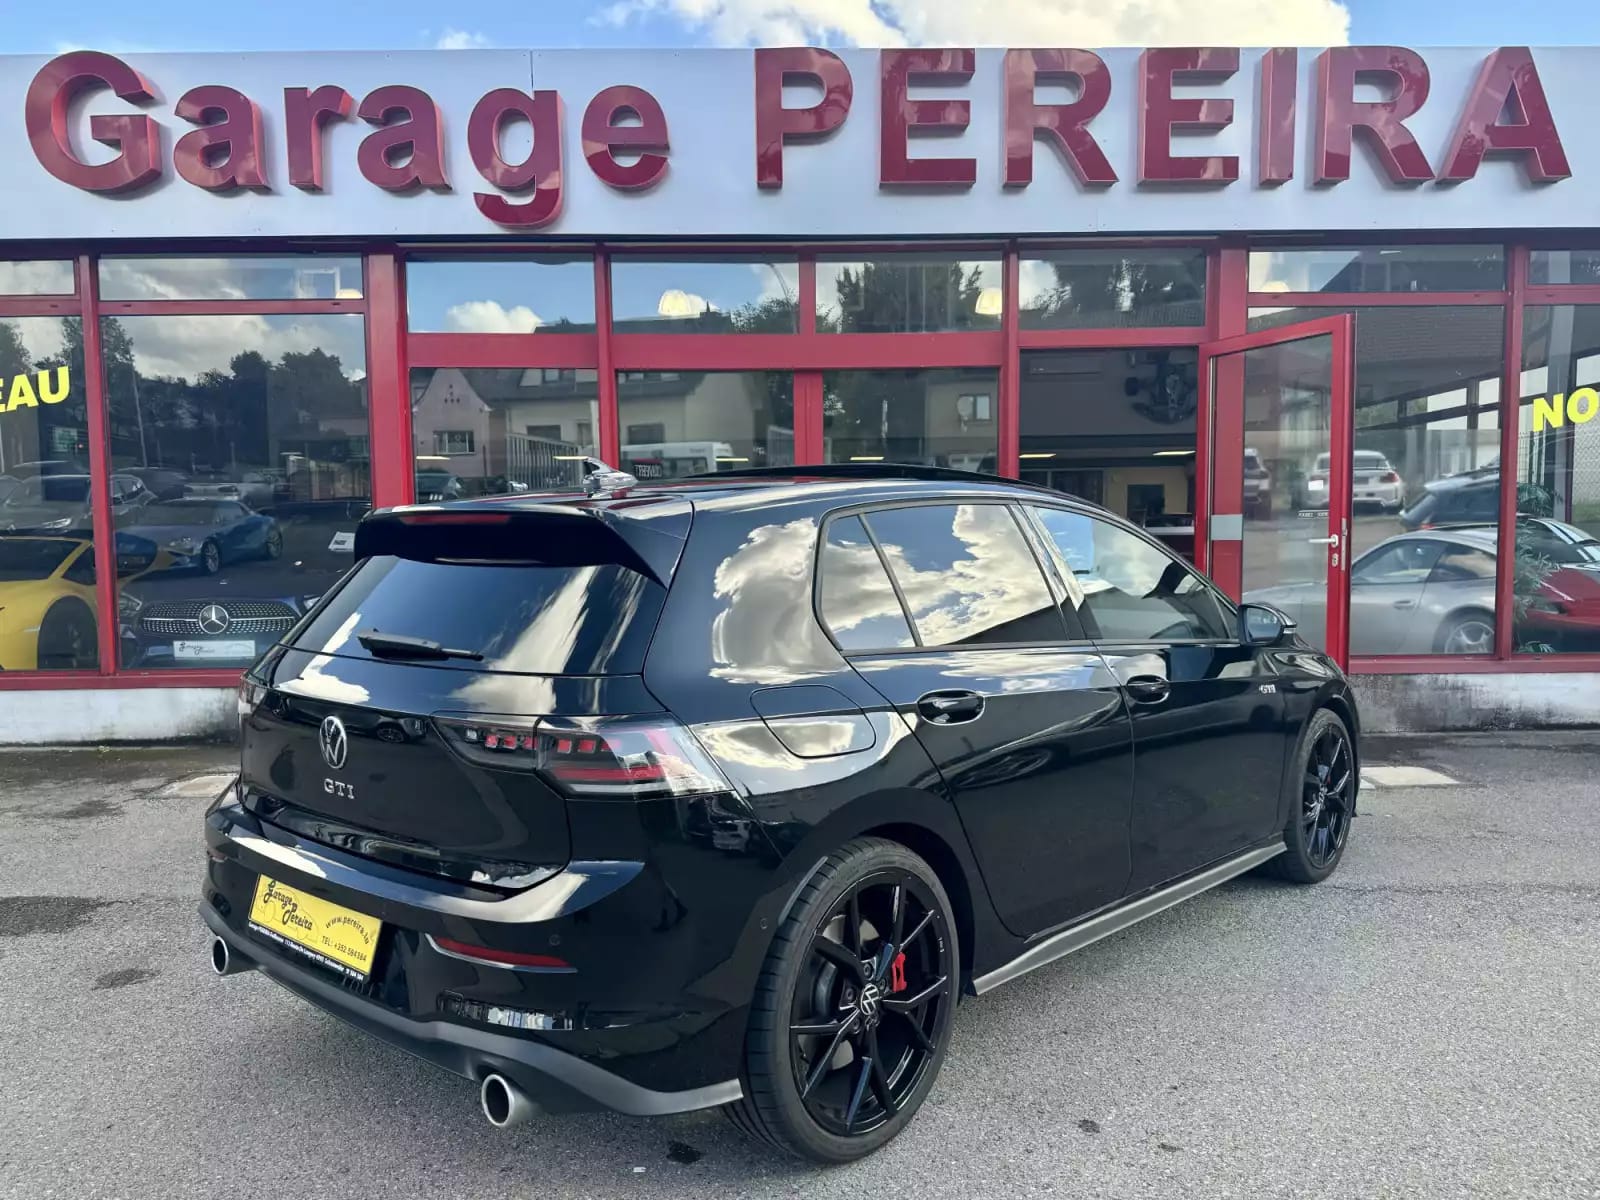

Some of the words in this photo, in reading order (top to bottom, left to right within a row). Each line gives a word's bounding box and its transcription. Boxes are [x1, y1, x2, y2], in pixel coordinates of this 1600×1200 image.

[25, 50, 671, 231] Garage
[755, 45, 1573, 188] PEREIRA
[1532, 387, 1599, 432] NO
[323, 778, 355, 799] GTI
[263, 880, 293, 909] Garage
[282, 902, 313, 931] Pereira
